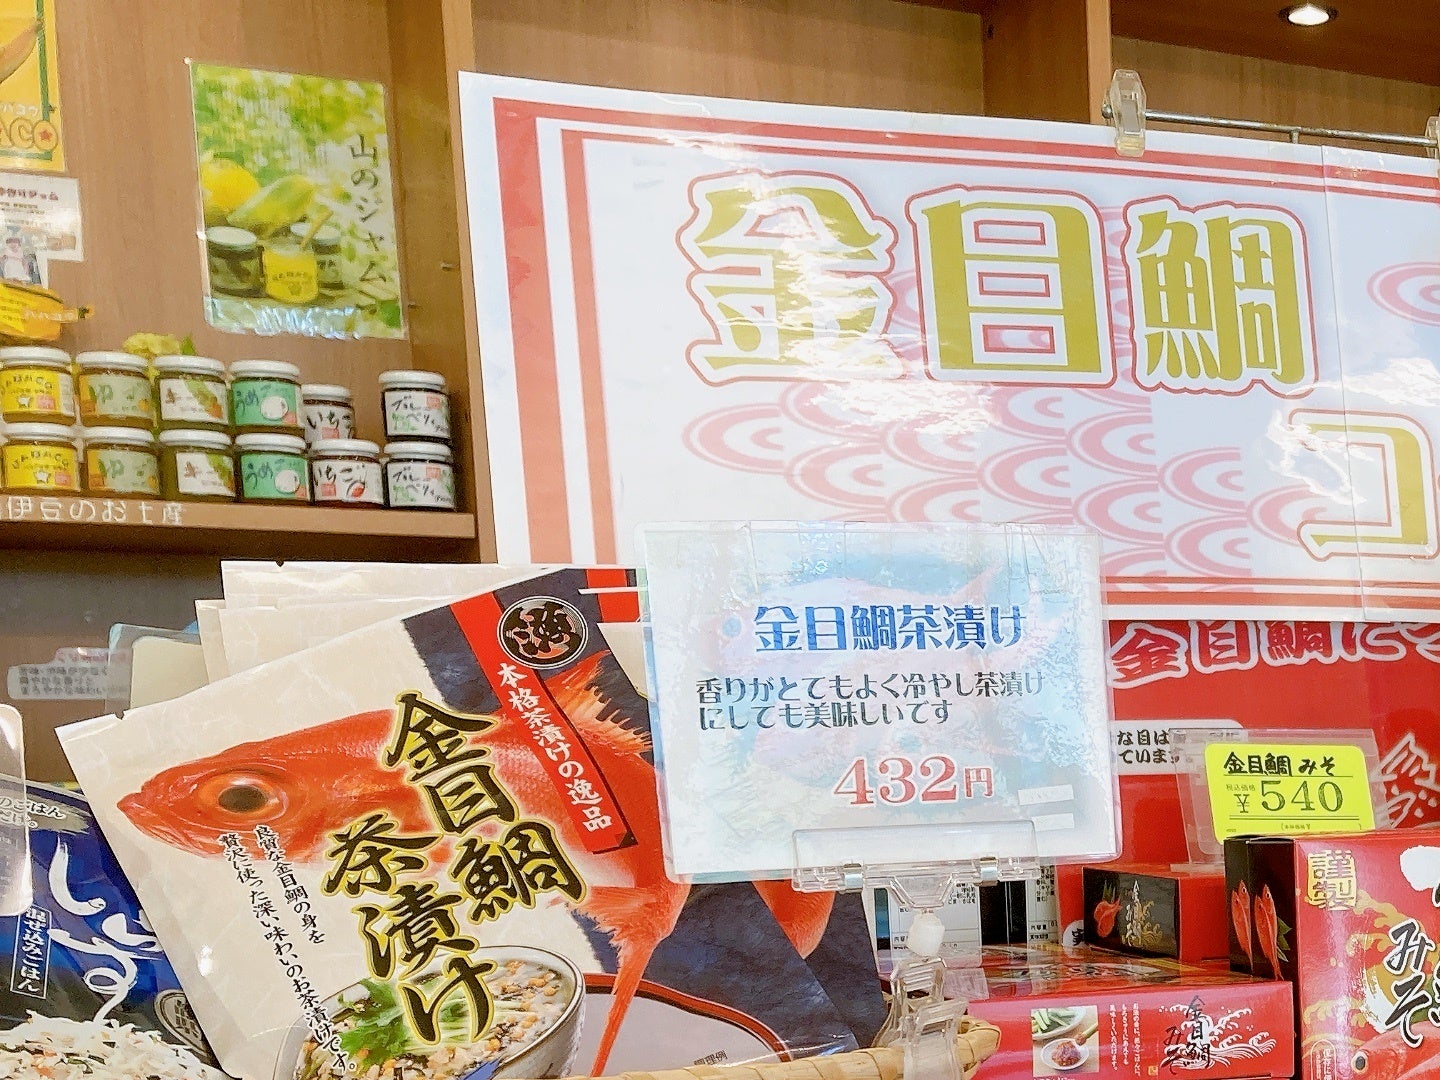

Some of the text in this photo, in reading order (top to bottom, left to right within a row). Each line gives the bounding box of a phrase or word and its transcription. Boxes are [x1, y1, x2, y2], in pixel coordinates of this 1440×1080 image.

[349, 133, 390, 283] 山のジャム
[678, 170, 1319, 397] 金目鯛
[6, 496, 184, 525] 伊豆のお土産
[696, 672, 1045, 704] 香りがとてもよく冷やし茶漬け
[753, 603, 1027, 652] 金目鯛茶漬け
[498, 662, 613, 832] 本格茶漬けの逸品
[700, 700, 953, 731] にしても美味しいです
[1223, 751, 1336, 777] 金目鯛 みそ
[381, 691, 586, 924] 金目鯛
[833, 755, 994, 806] 432円
[1234, 779, 1344, 814] ¥540
[254, 824, 327, 945] 良質な金目鯛の身を
[321, 812, 500, 1047] 茶漬け
[220, 834, 357, 1074] 贅沢に使った深い味わいのお茶漬けです。
[1383, 918, 1437, 1048] みそ
